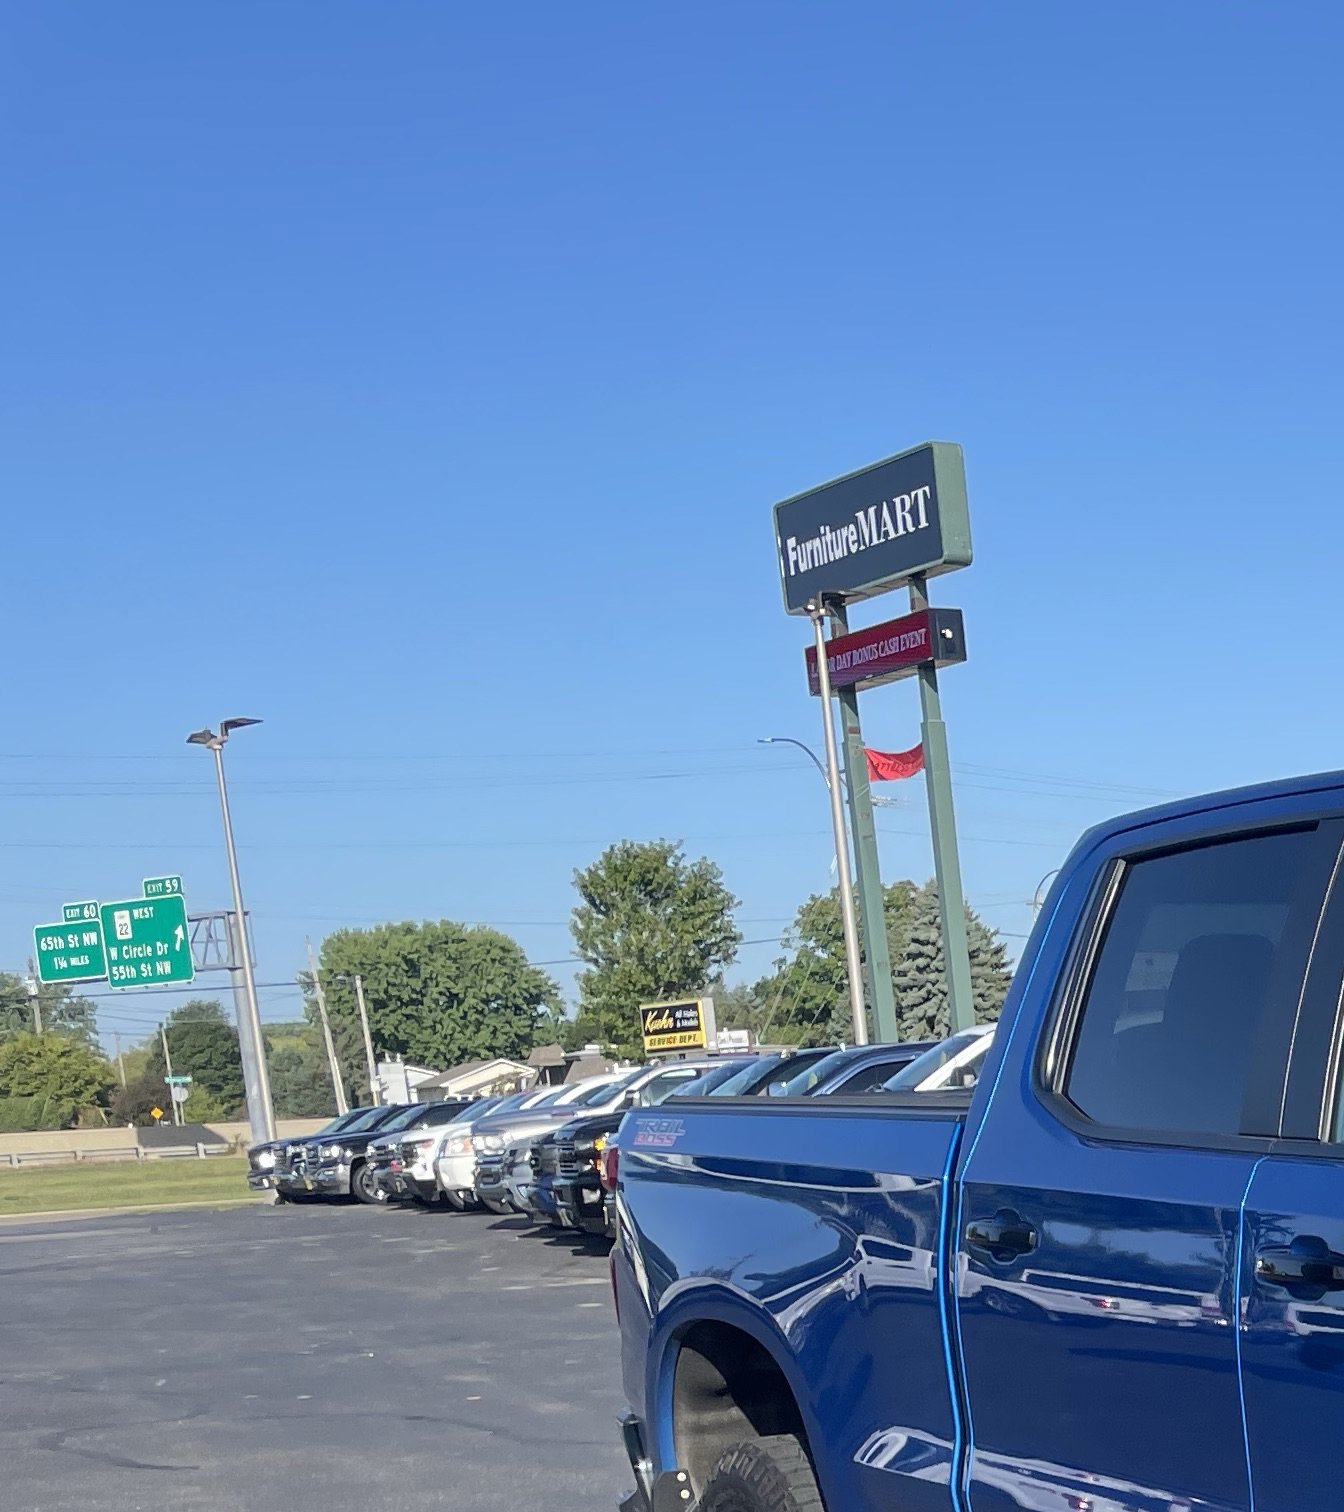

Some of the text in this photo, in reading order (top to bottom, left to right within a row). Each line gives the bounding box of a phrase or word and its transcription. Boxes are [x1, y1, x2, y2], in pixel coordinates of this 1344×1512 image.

[786, 485, 932, 576] FurnitureMART
[836, 650, 852, 670] DAY
[852, 643, 878, 665] BONUS
[879, 636, 900, 657] CASH
[900, 628, 927, 651] EVENT
[147, 879, 178, 894] EXIT 59
[66, 904, 96, 919] EXIT 60
[133, 907, 154, 919] WEST
[118, 923, 129, 936] 22
[40, 931, 98, 951] 65th St NW
[109, 942, 169, 961] W Circle Dr
[70, 956, 90, 966] MILES
[112, 961, 172, 980] 55th St NW
[649, 1036, 677, 1047] SERVICE
[636, 1118, 686, 1136] TRAIL
[634, 1134, 676, 1146] BOSS
